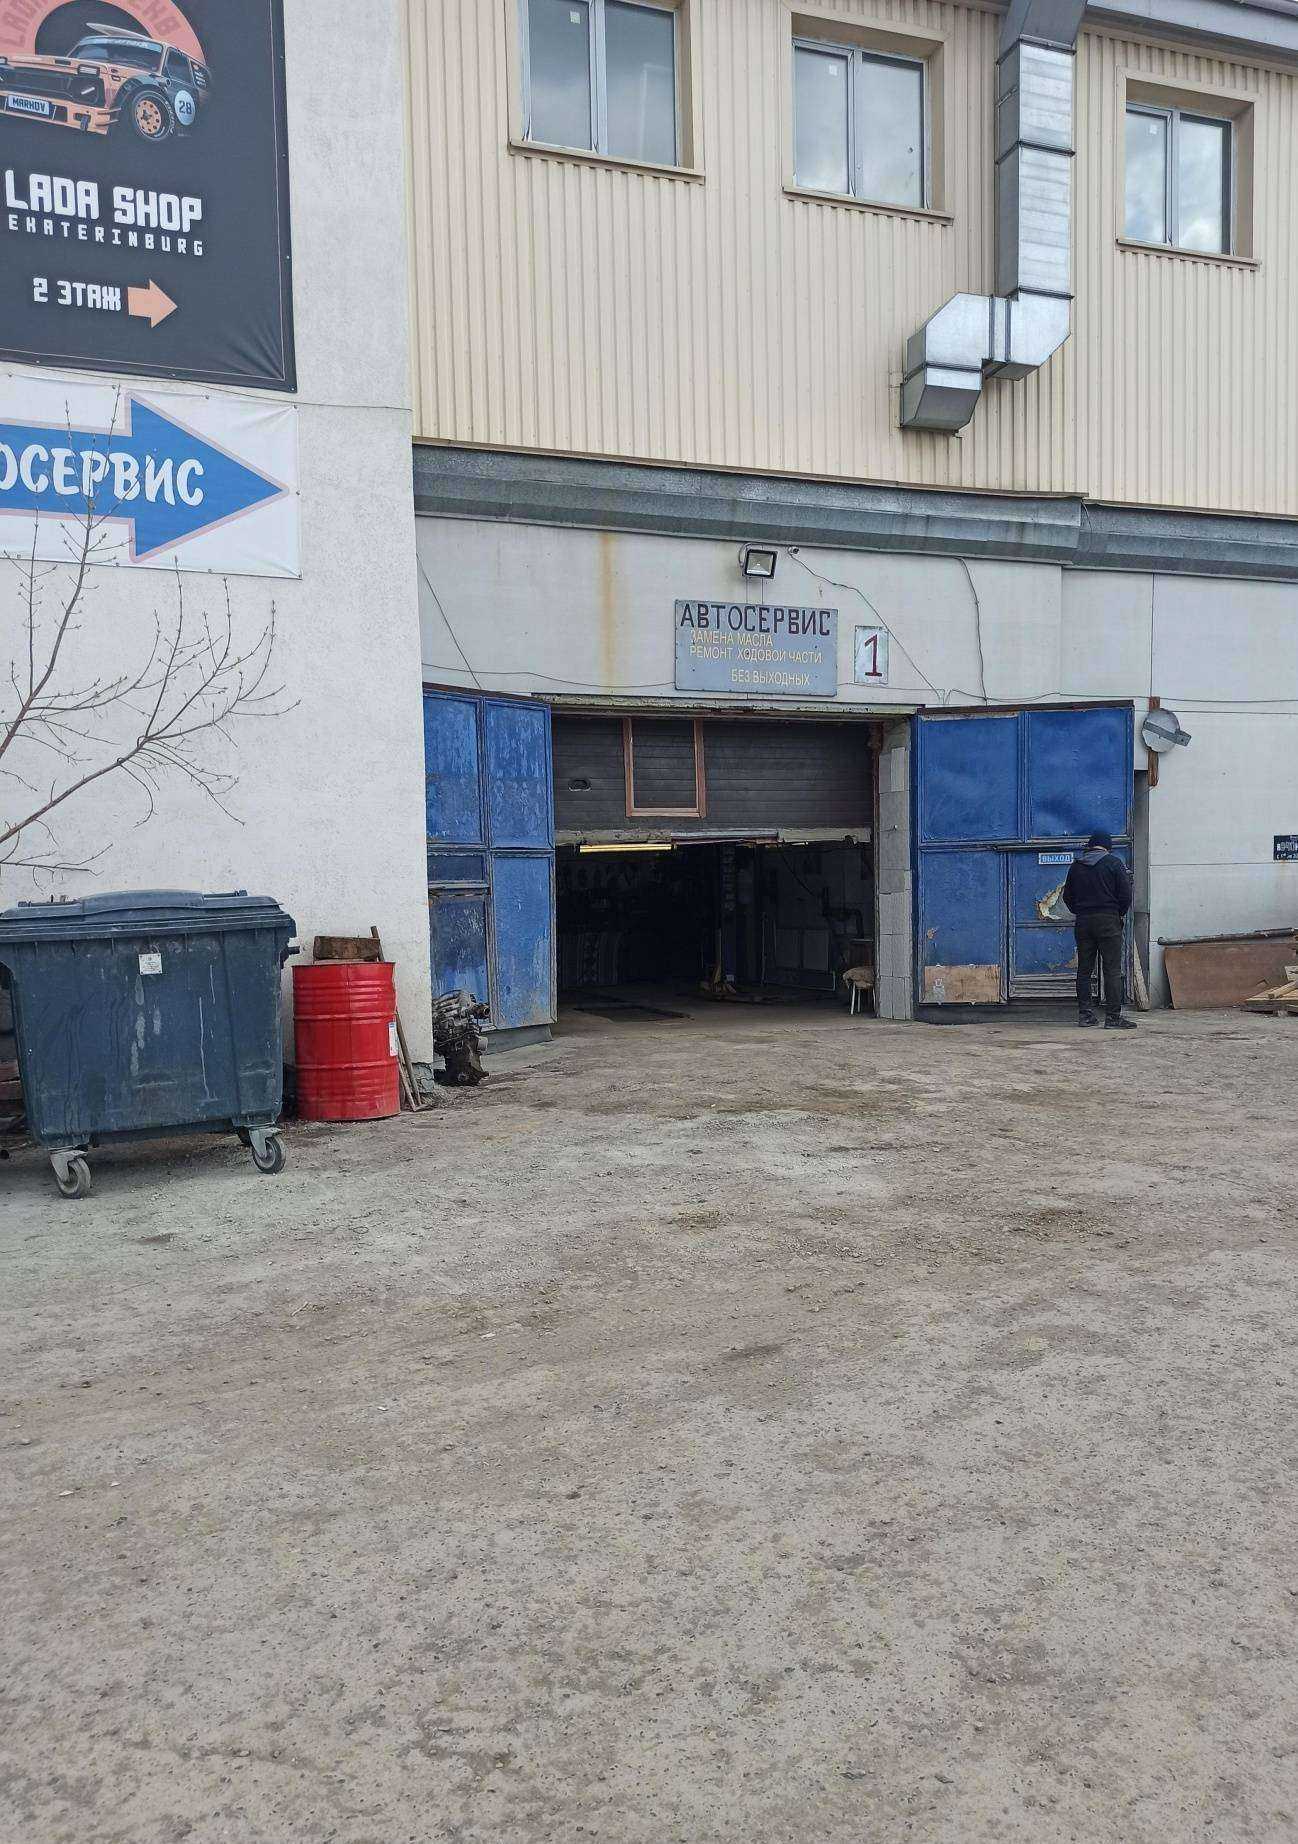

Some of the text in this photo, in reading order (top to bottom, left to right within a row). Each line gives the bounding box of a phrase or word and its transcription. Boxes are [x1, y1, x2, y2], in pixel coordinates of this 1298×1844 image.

[178, 101, 193, 114] 28
[5, 169, 203, 233] LADA SHOP
[32, 277, 122, 312] 2 ЭТАЖ
[680, 602, 831, 636] АВТОСЕРВИС
[690, 645, 733, 659] РЕМОНТ
[788, 651, 823, 664] ЧАСТИ
[864, 634, 883, 677] 1
[731, 668, 811, 686] БЕЗ ВЫХОДНЫХ
